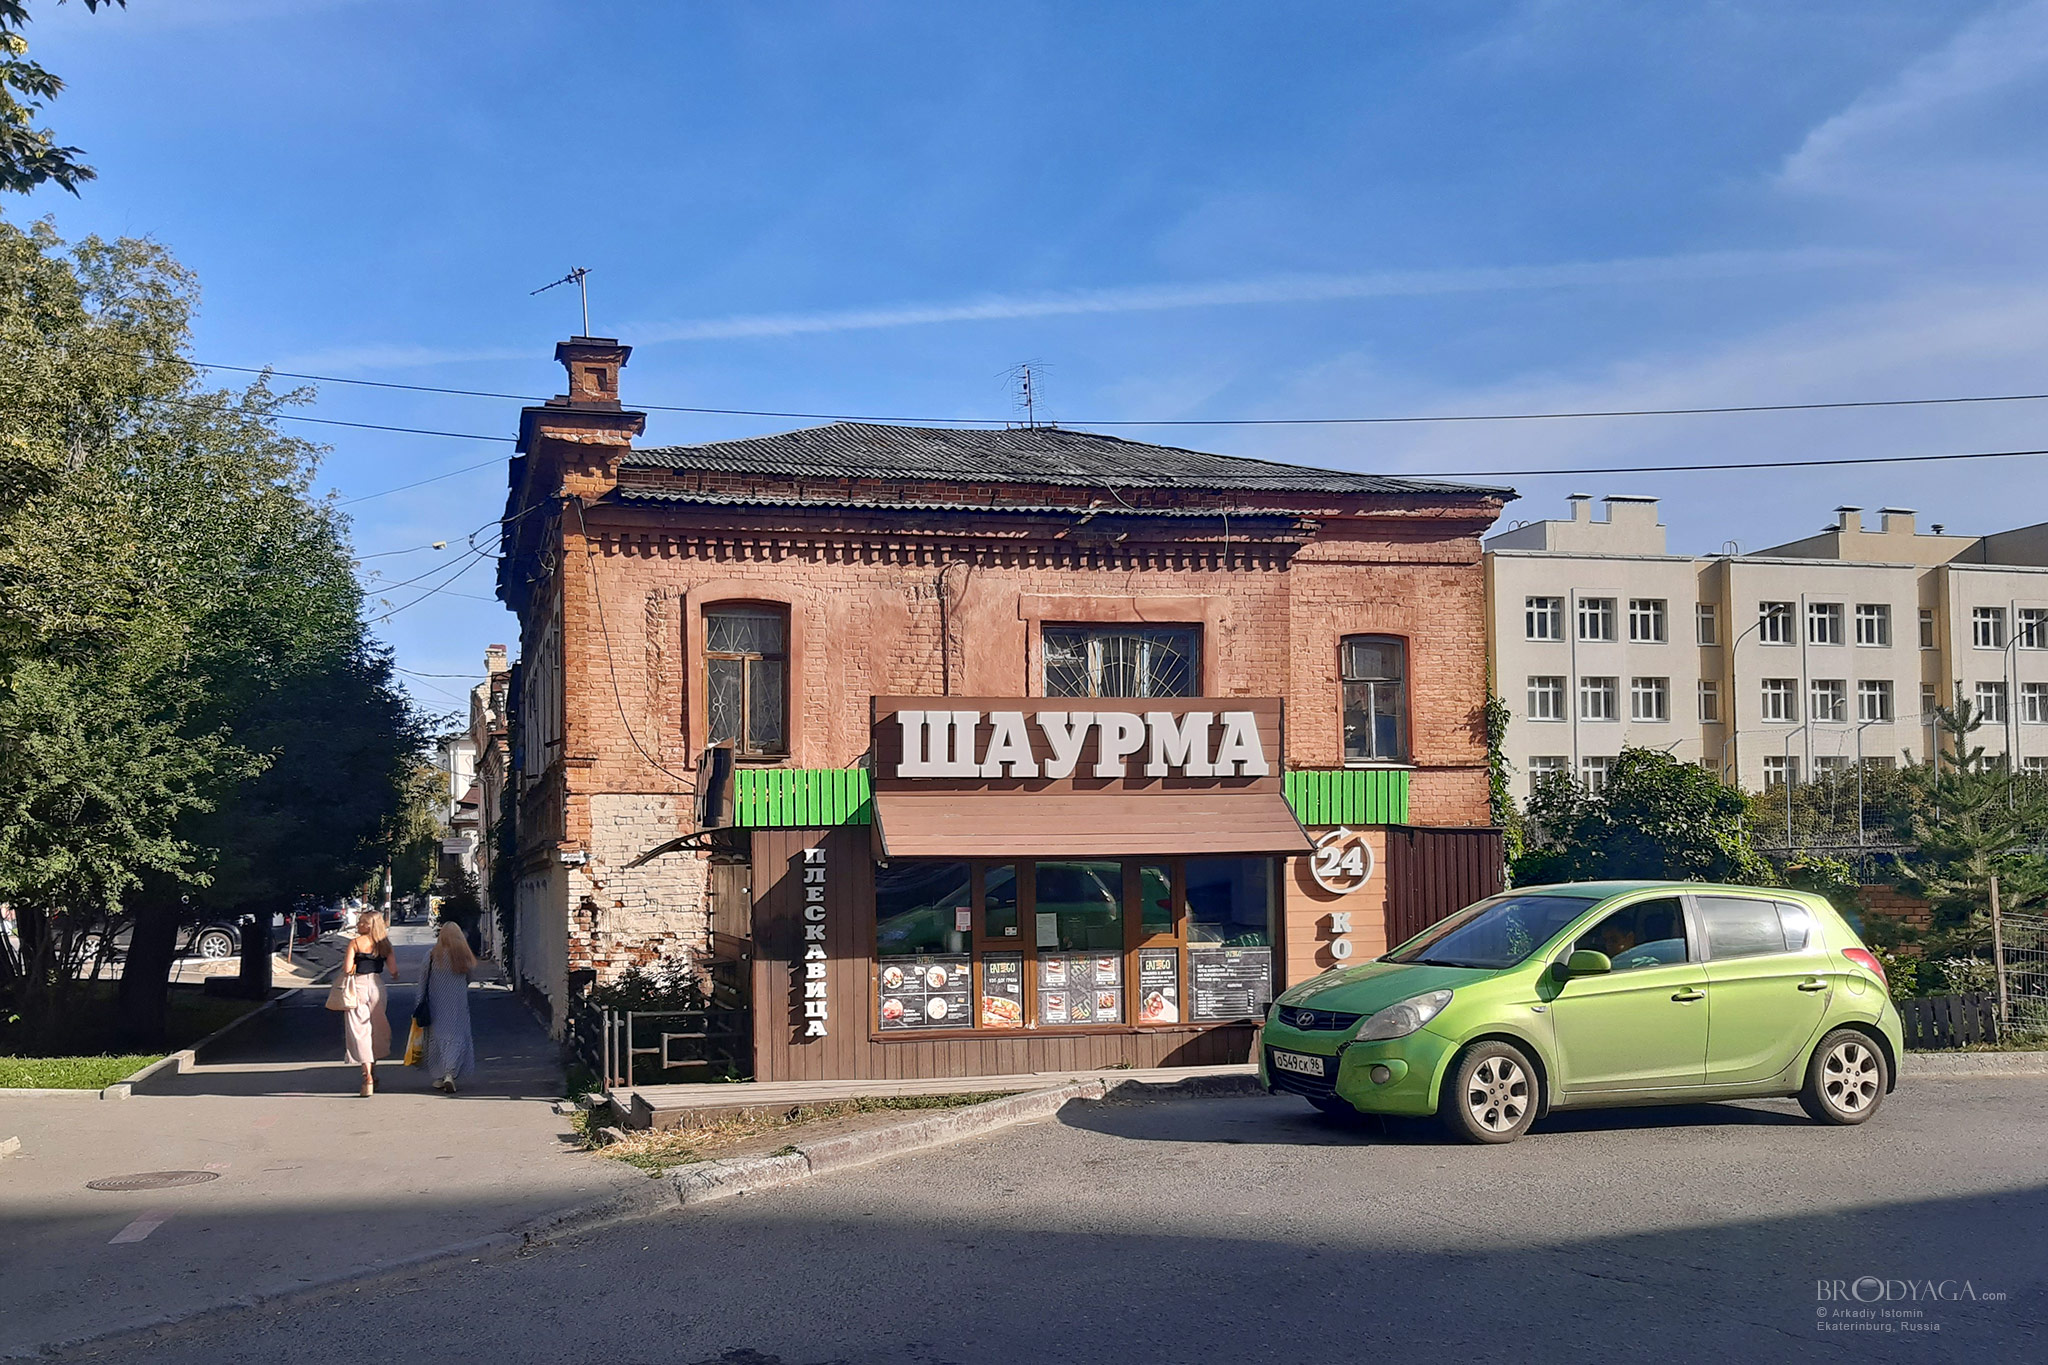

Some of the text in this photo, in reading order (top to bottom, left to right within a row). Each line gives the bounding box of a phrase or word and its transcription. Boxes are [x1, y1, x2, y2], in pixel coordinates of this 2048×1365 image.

[897, 710, 1269, 778] ШАУРМА
[1317, 846, 1363, 876] 24
[803, 848, 828, 1037] ПЛЕСКАВИЦА
[1310, 1058, 1320, 1070] 96
